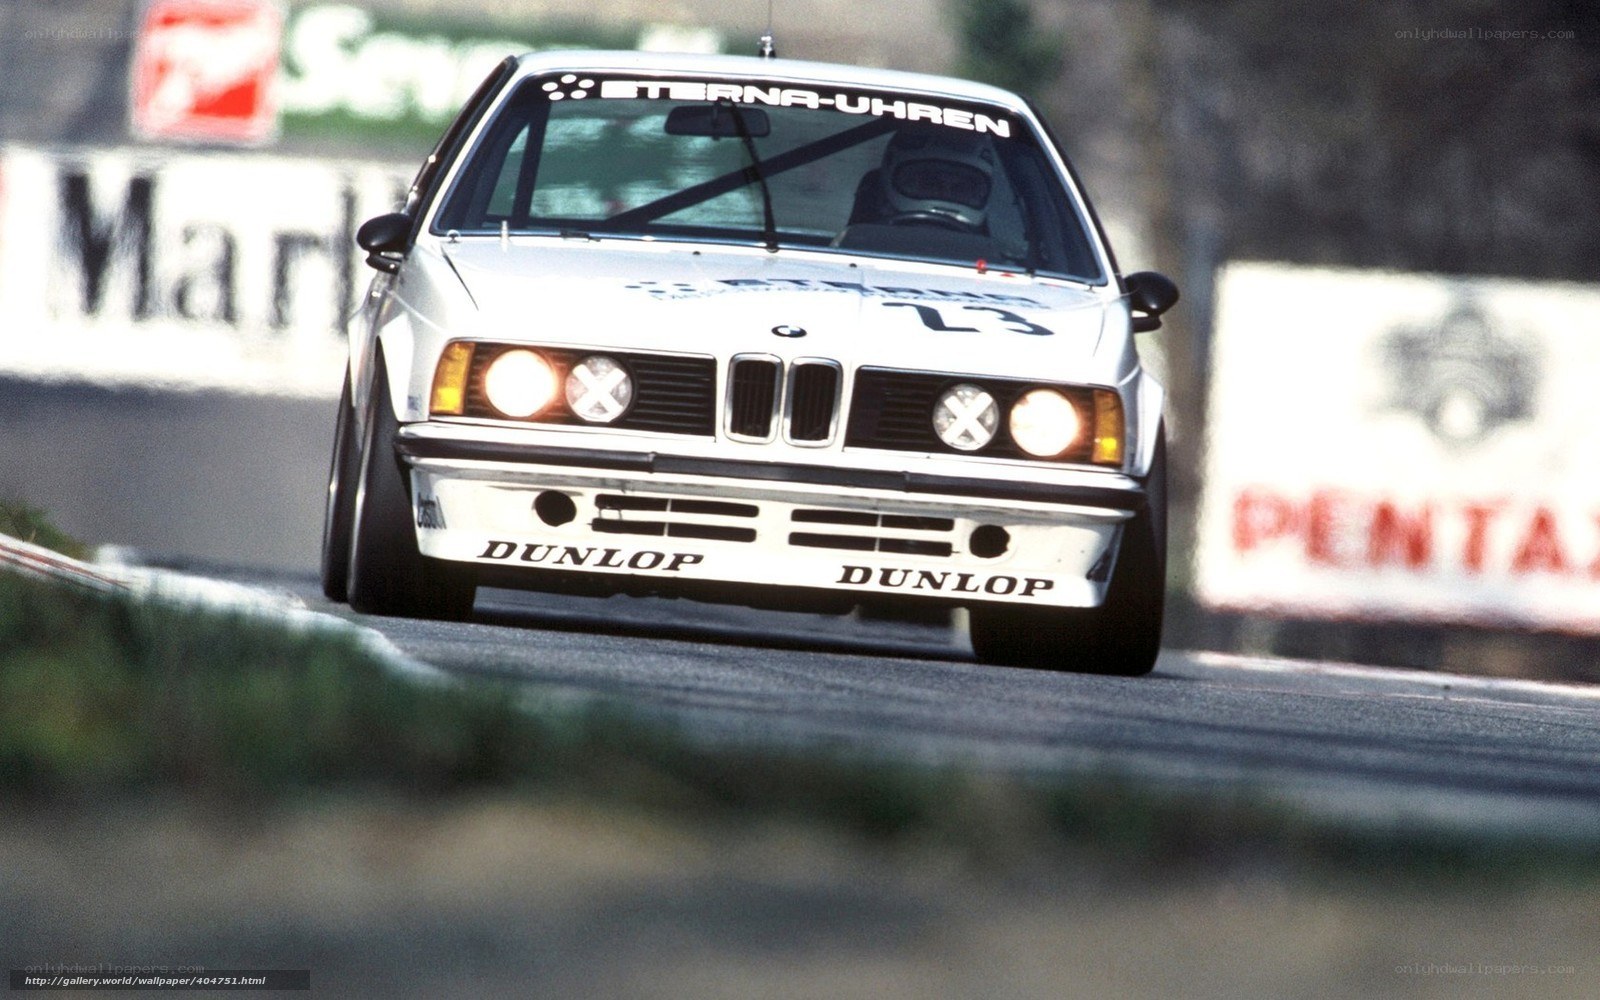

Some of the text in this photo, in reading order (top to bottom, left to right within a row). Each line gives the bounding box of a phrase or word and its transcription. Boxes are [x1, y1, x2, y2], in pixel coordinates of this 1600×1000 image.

[601, 80, 1010, 138] ETERNA-UHREN
[57, 168, 407, 332] Marl
[478, 541, 704, 571] DUNLOP
[1233, 488, 1600, 580] PENTA
[837, 566, 1055, 596] DUNLOP
